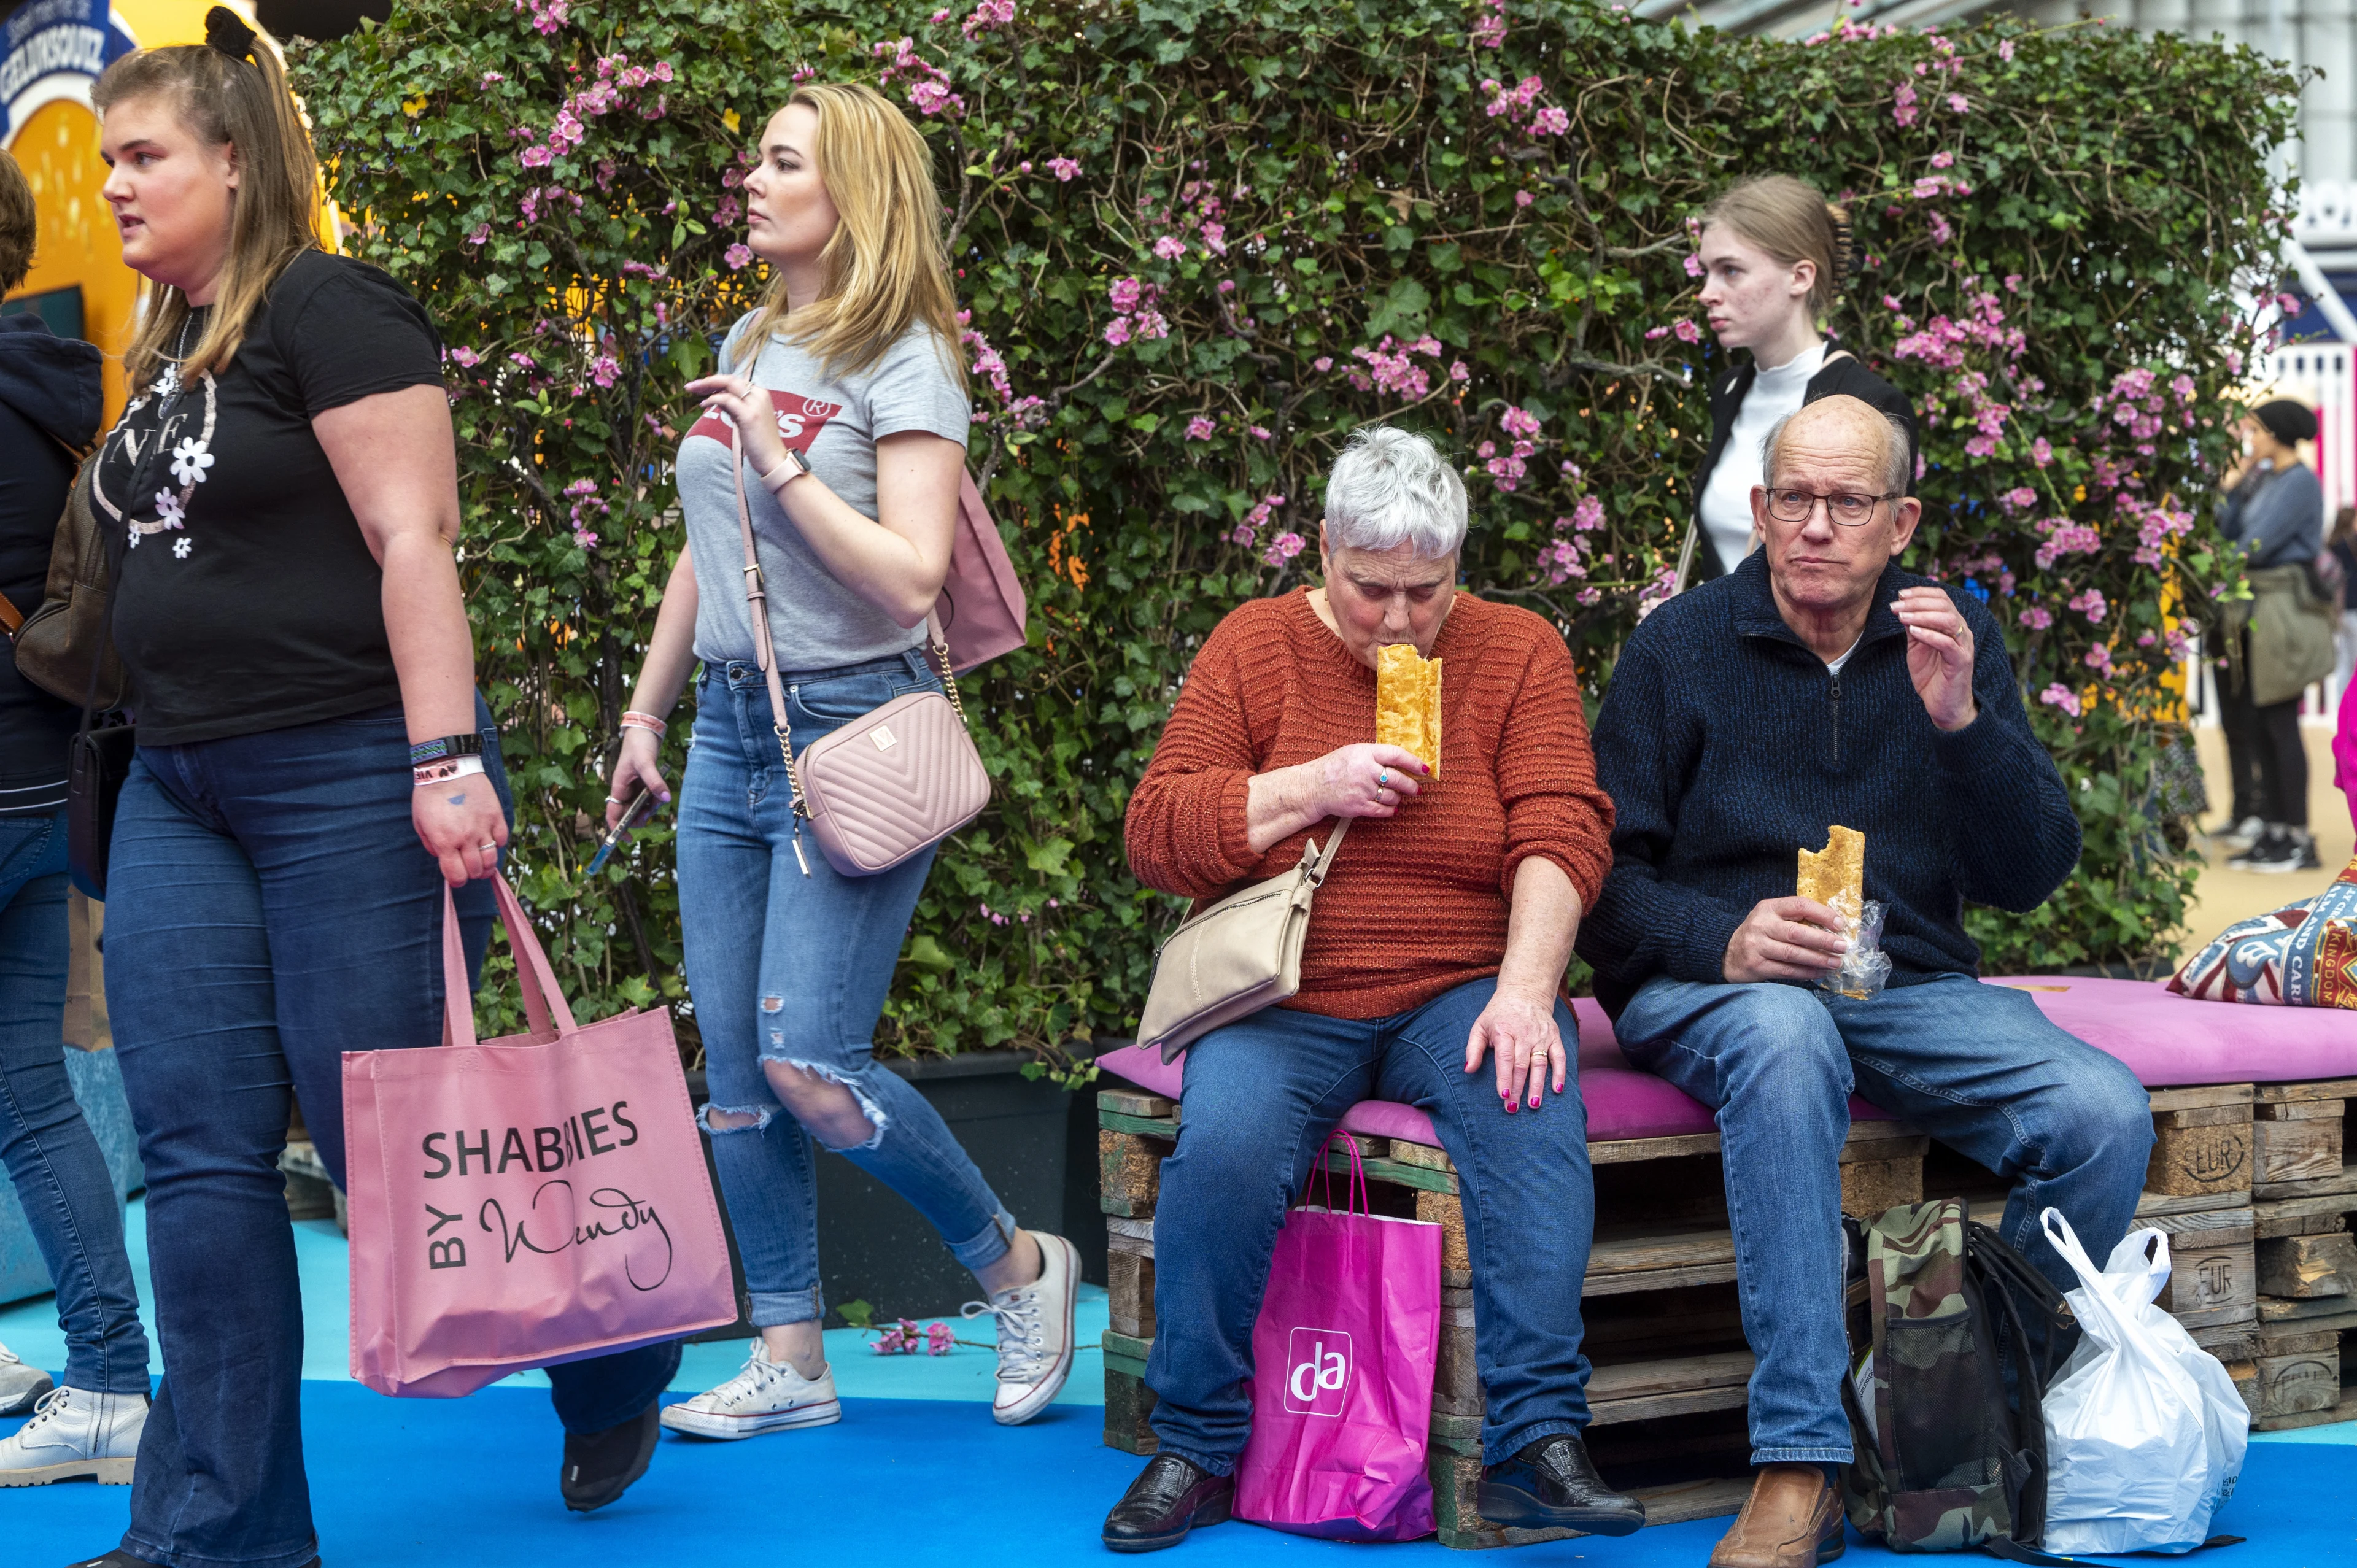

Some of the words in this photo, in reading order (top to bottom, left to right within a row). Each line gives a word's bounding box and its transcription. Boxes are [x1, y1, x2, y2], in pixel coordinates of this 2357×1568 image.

[2296, 916, 2318, 950] AND
[2323, 932, 2342, 1002] KINGDOM
[422, 1100, 638, 1180] SHABBIES
[2196, 1139, 2231, 1174] EUR
[425, 1203, 466, 1270] BY
[479, 1180, 672, 1291] Wendy
[1290, 1342, 1345, 1402] da
